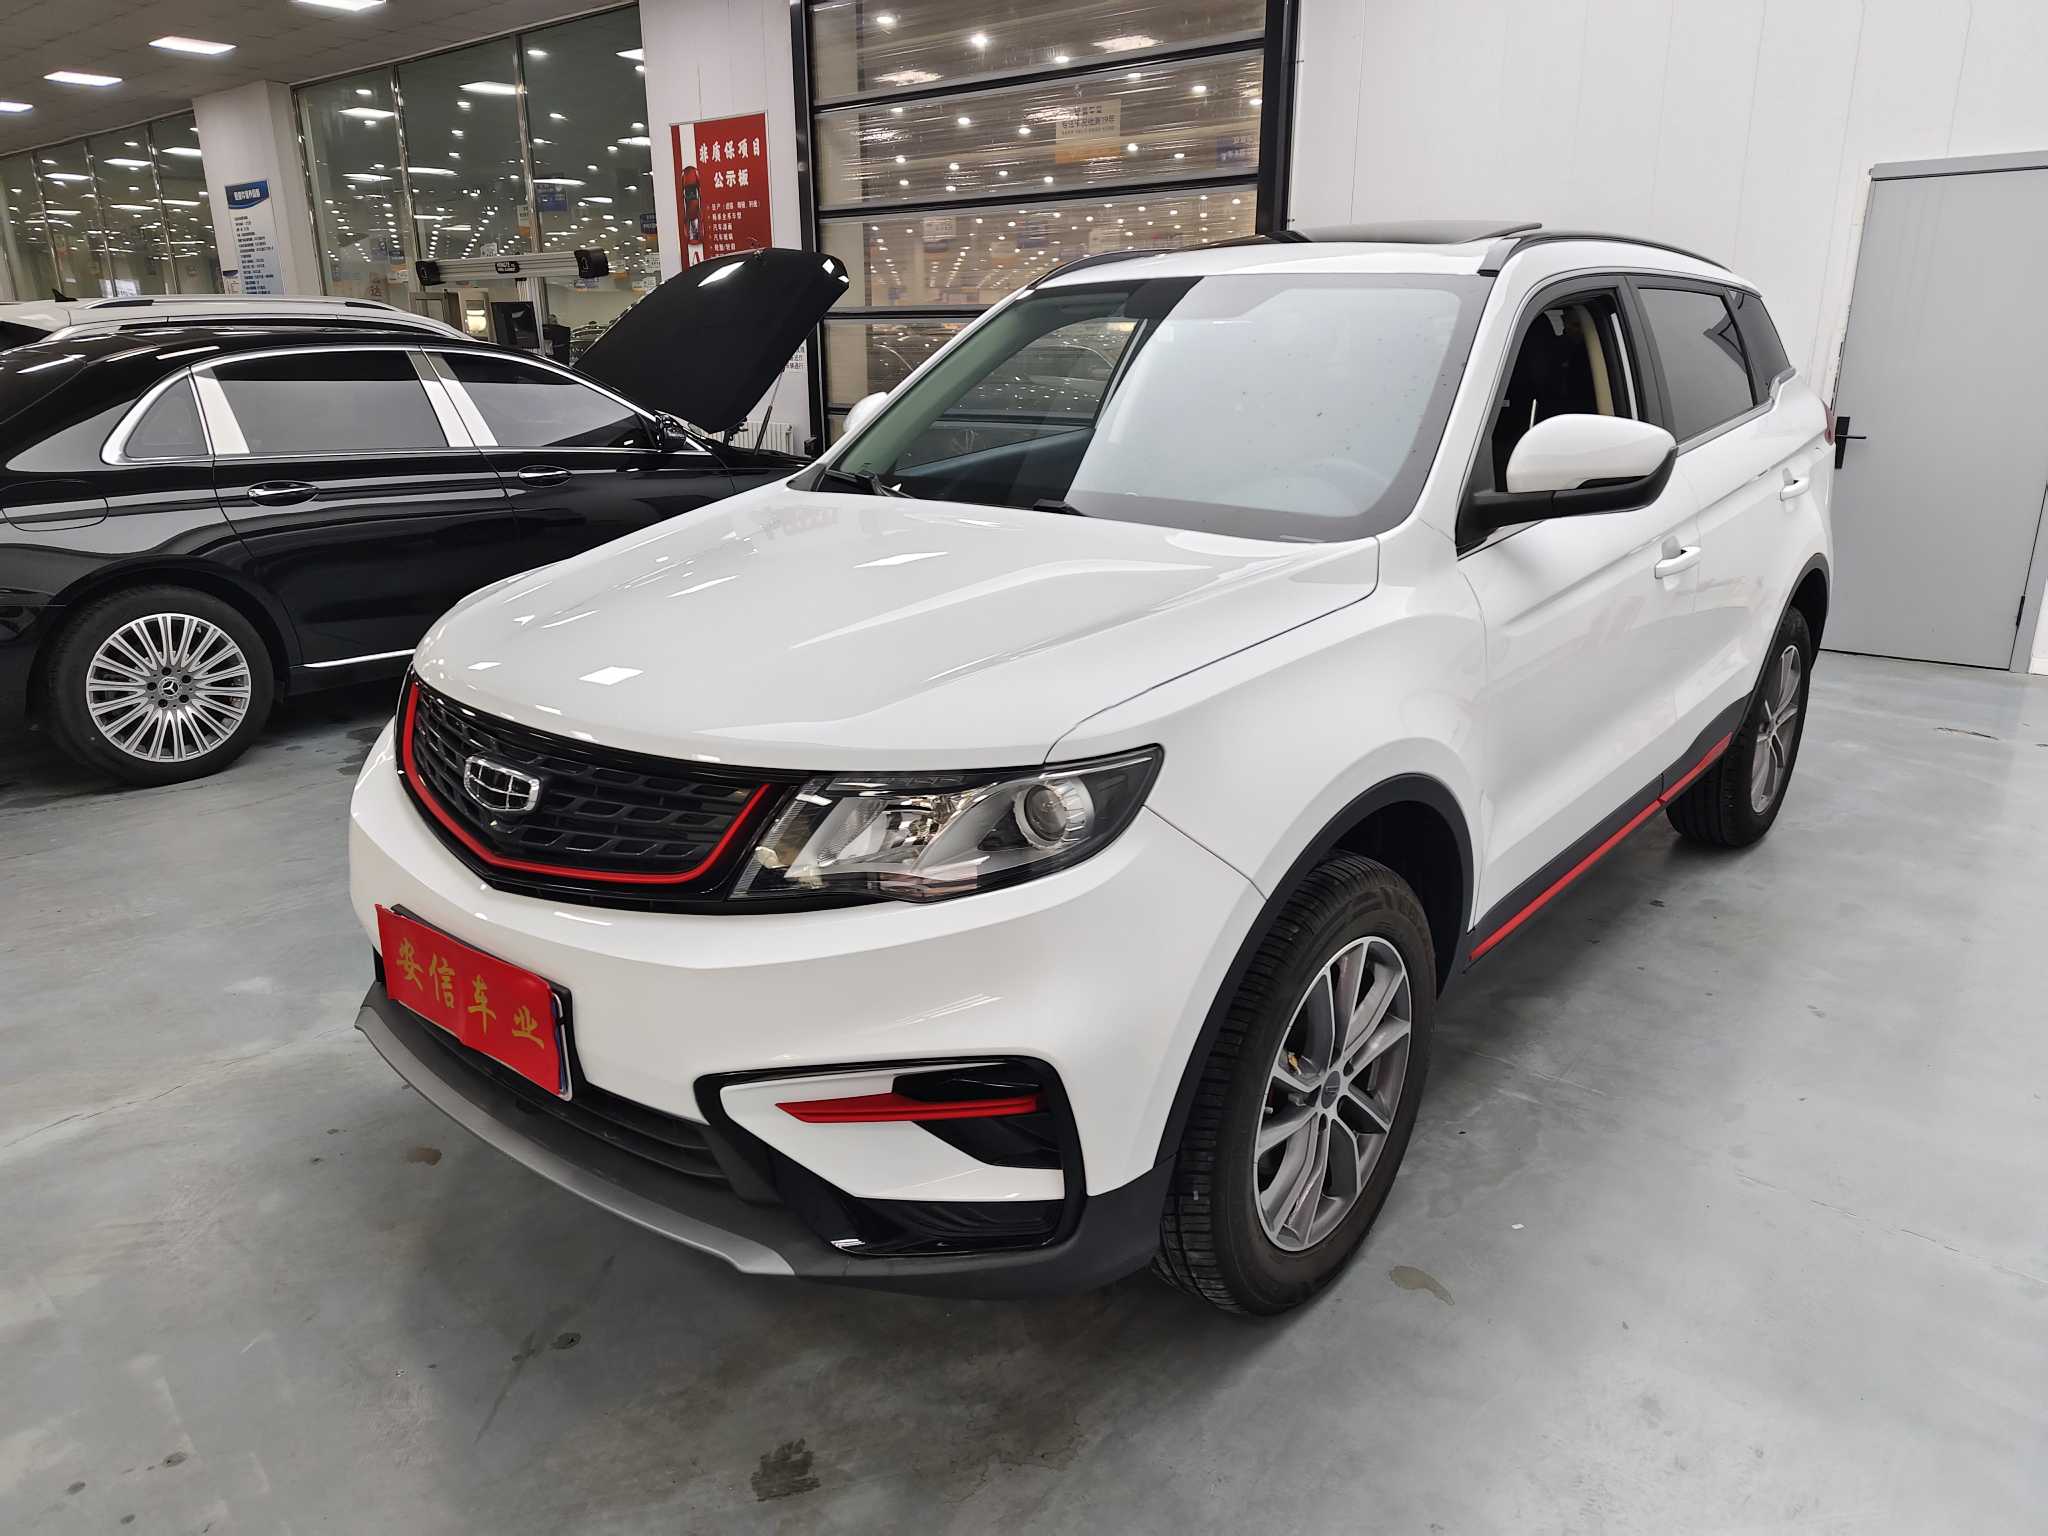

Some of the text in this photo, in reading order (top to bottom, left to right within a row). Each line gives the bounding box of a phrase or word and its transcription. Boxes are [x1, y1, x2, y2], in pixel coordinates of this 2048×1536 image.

[699, 137, 761, 164] 非质保项目
[713, 169, 749, 188] 公示板
[396, 937, 545, 1050] 安信车业
